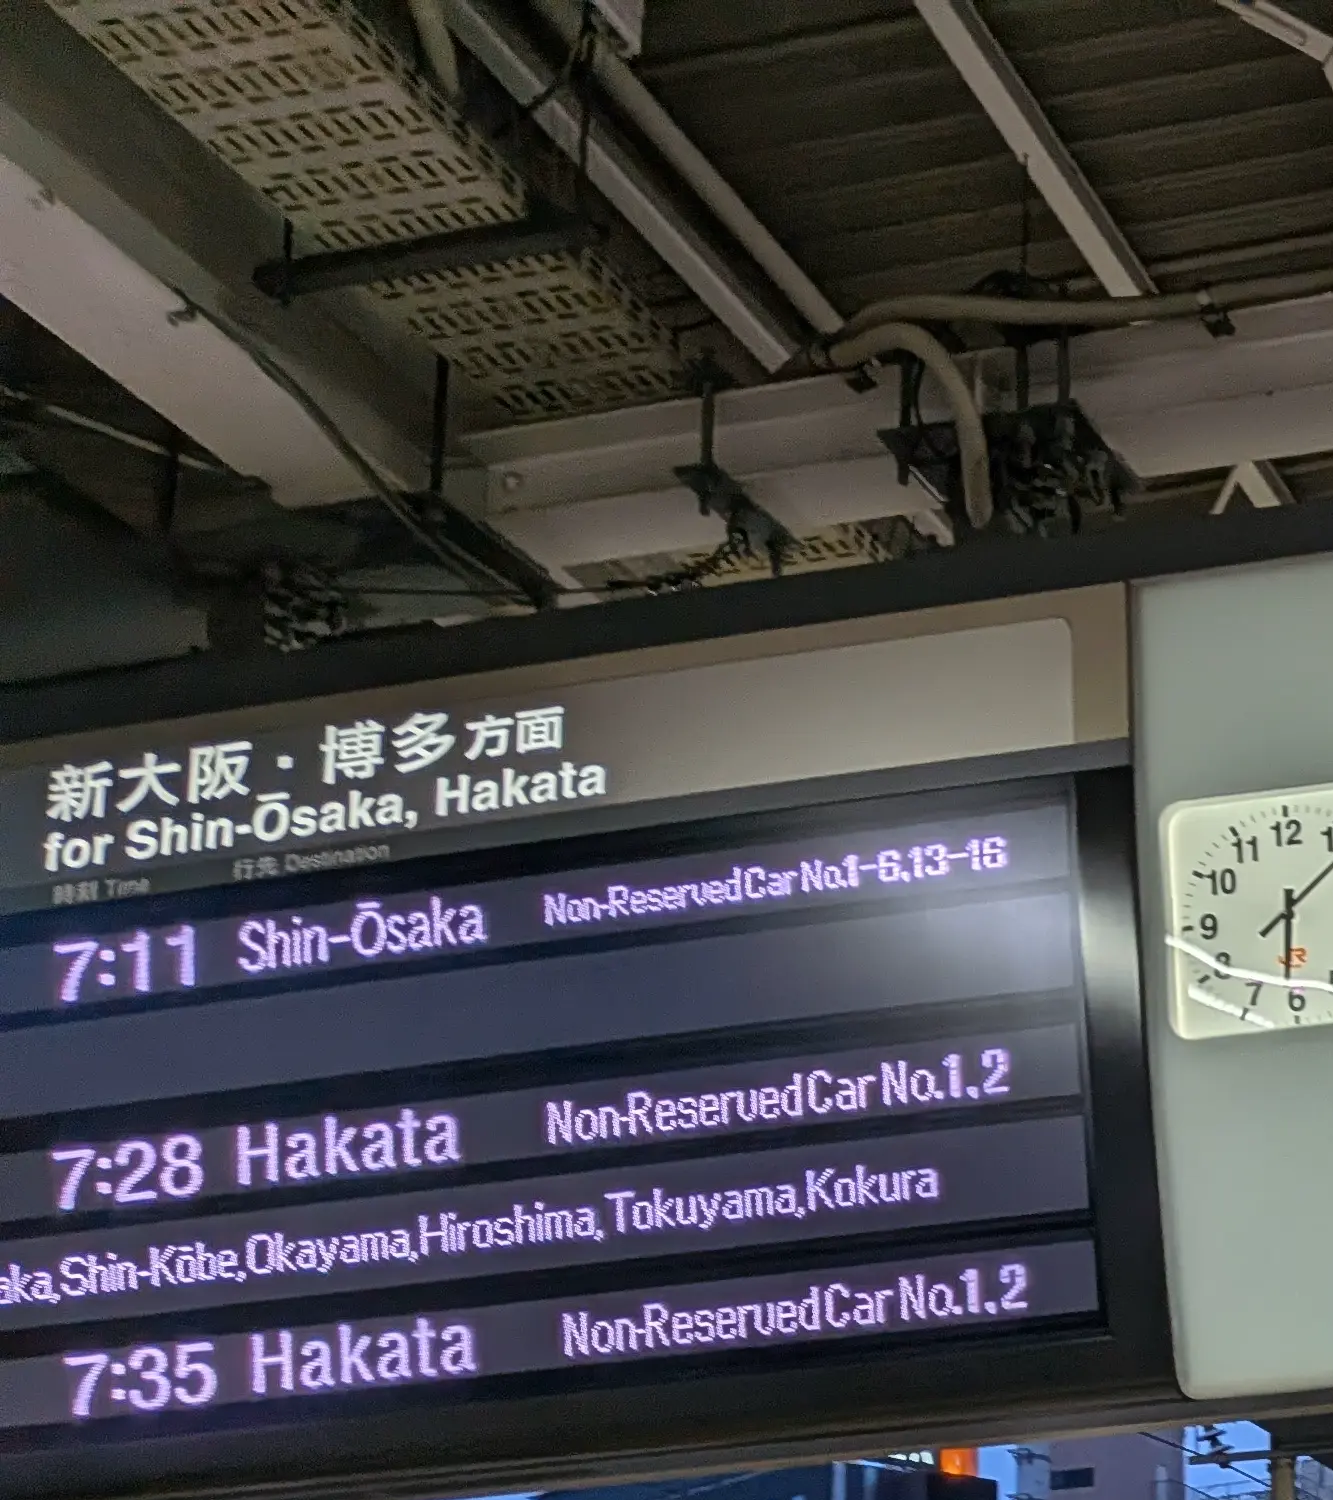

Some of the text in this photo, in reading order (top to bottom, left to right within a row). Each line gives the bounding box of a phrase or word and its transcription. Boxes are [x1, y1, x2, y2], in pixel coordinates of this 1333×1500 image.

[42, 761, 608, 872] for Shin-Ōsaka, Hakata
[1270, 819, 1303, 847] 12
[1232, 836, 1259, 863] 11
[1207, 868, 1237, 895] 10
[1200, 913, 1218, 940] 9
[52, 924, 198, 1004] 7:11
[236, 896, 489, 975] Shin-Ōsaka
[1214, 951, 1232, 979] 8
[1245, 980, 1263, 1006] 7
[1288, 986, 1306, 1012] 6
[51, 1133, 204, 1213] 7:28
[235, 1107, 462, 1187] Hakata
[62, 1340, 219, 1420] 7:35
[248, 1315, 478, 1397] Hakata
